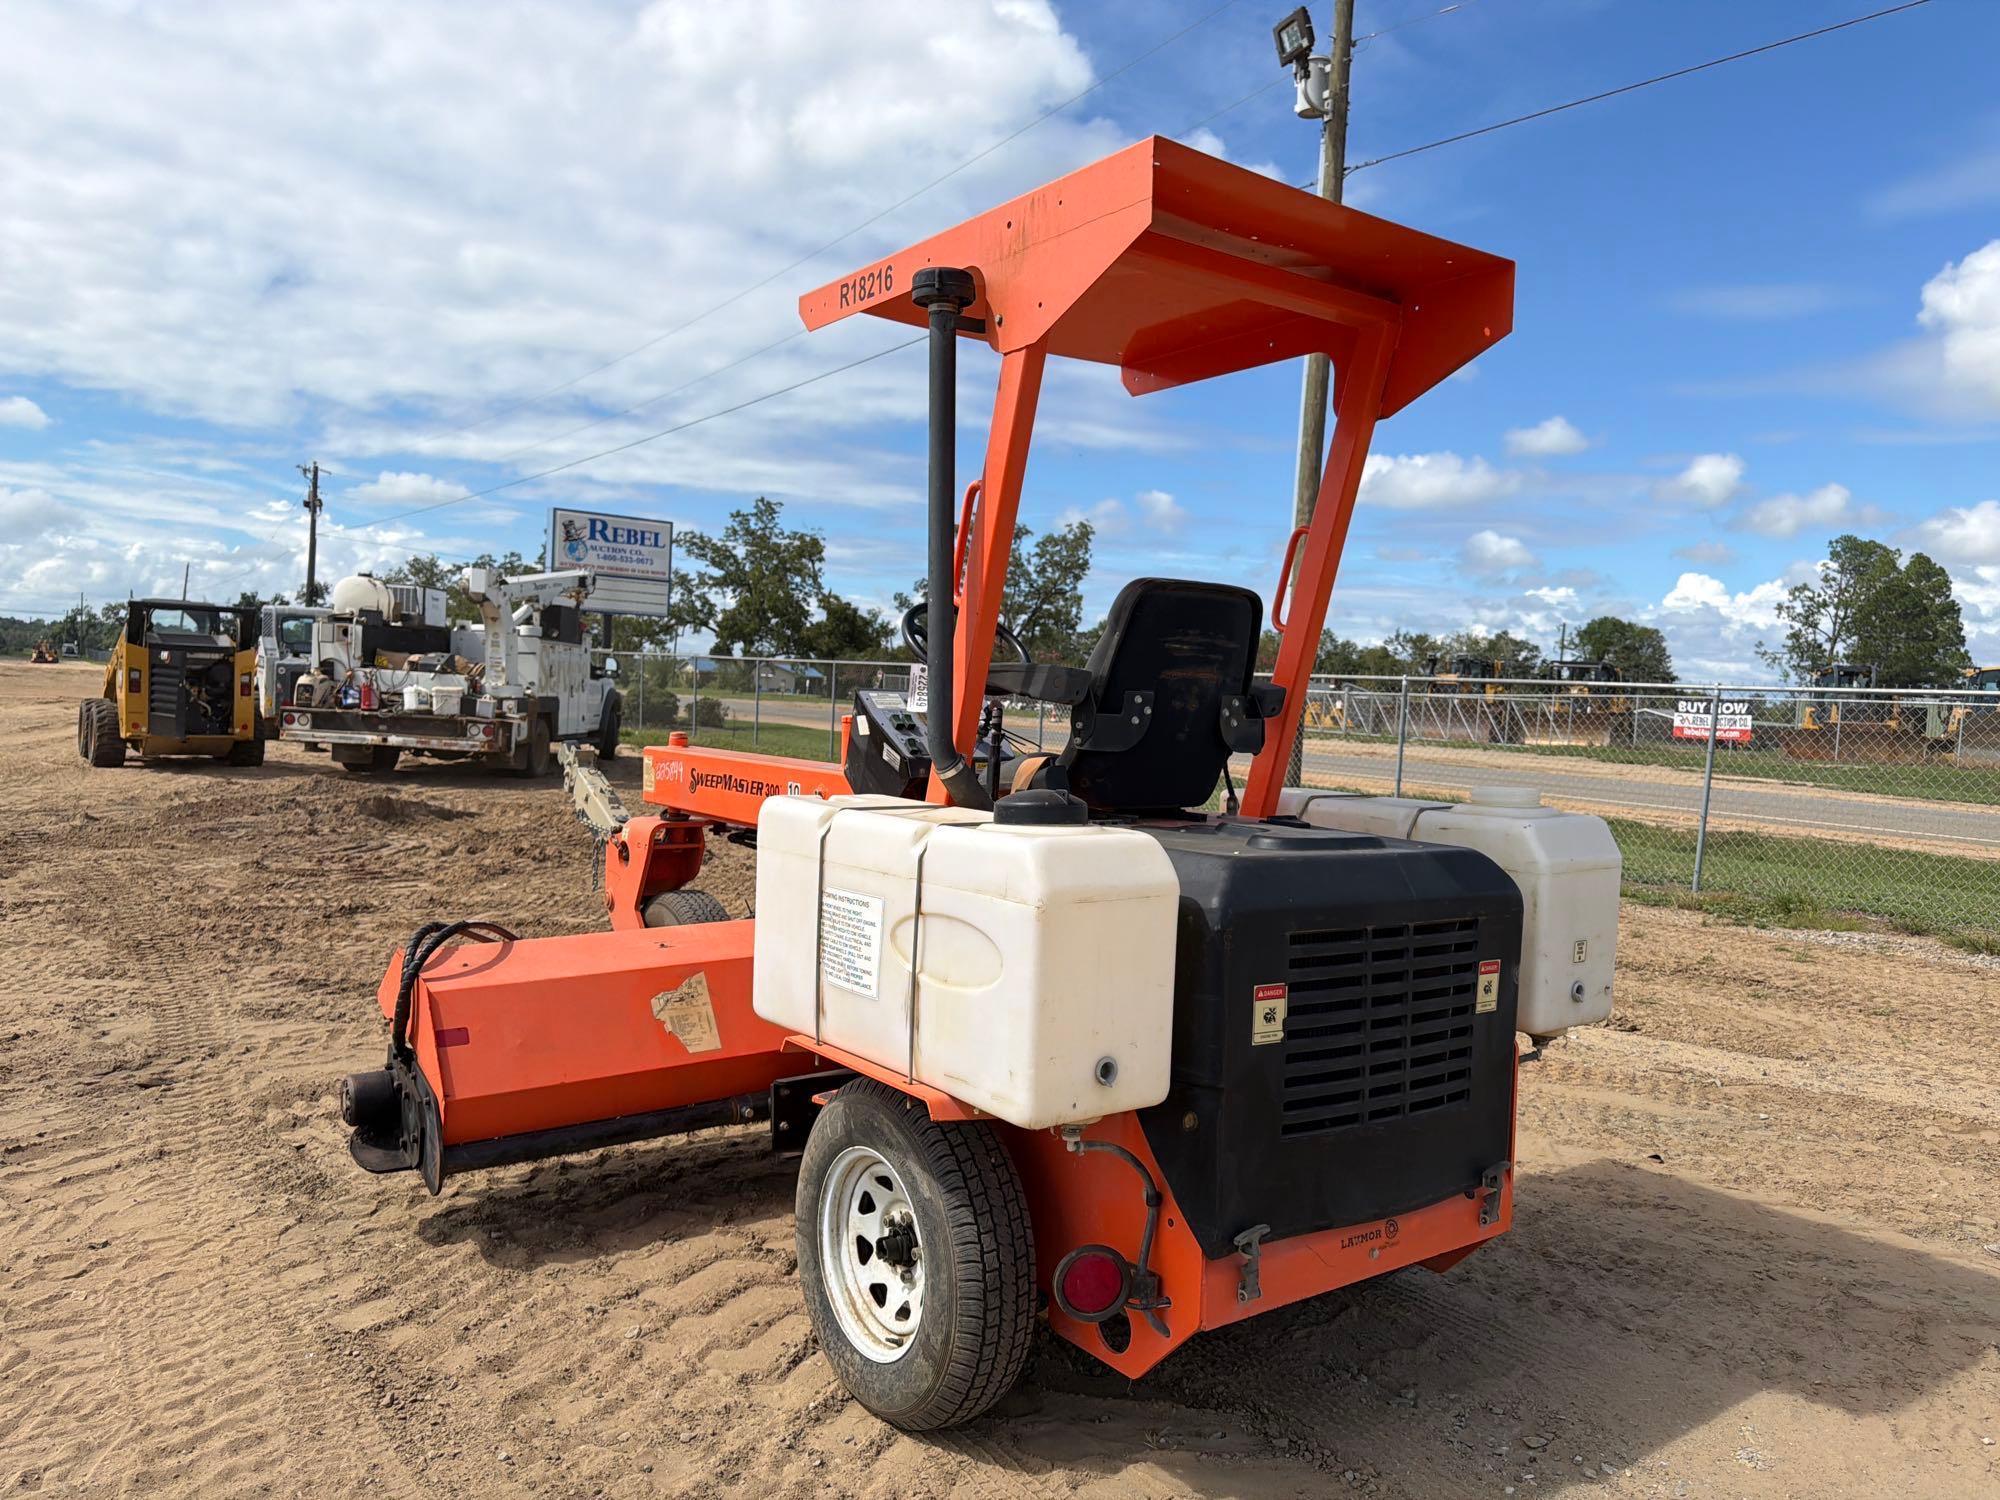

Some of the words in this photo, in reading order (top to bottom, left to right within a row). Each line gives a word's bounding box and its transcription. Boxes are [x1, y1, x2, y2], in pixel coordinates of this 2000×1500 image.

[840, 264, 893, 309] R18216
[588, 518, 666, 548] REBEL
[590, 544, 627, 555] AUCTION
[916, 674, 928, 707] 225849
[1678, 700, 1707, 713] BUY
[765, 783, 780, 797] 300
[838, 895, 869, 908] INSTRUCTIONS
[1264, 988, 1283, 997] DANGER
